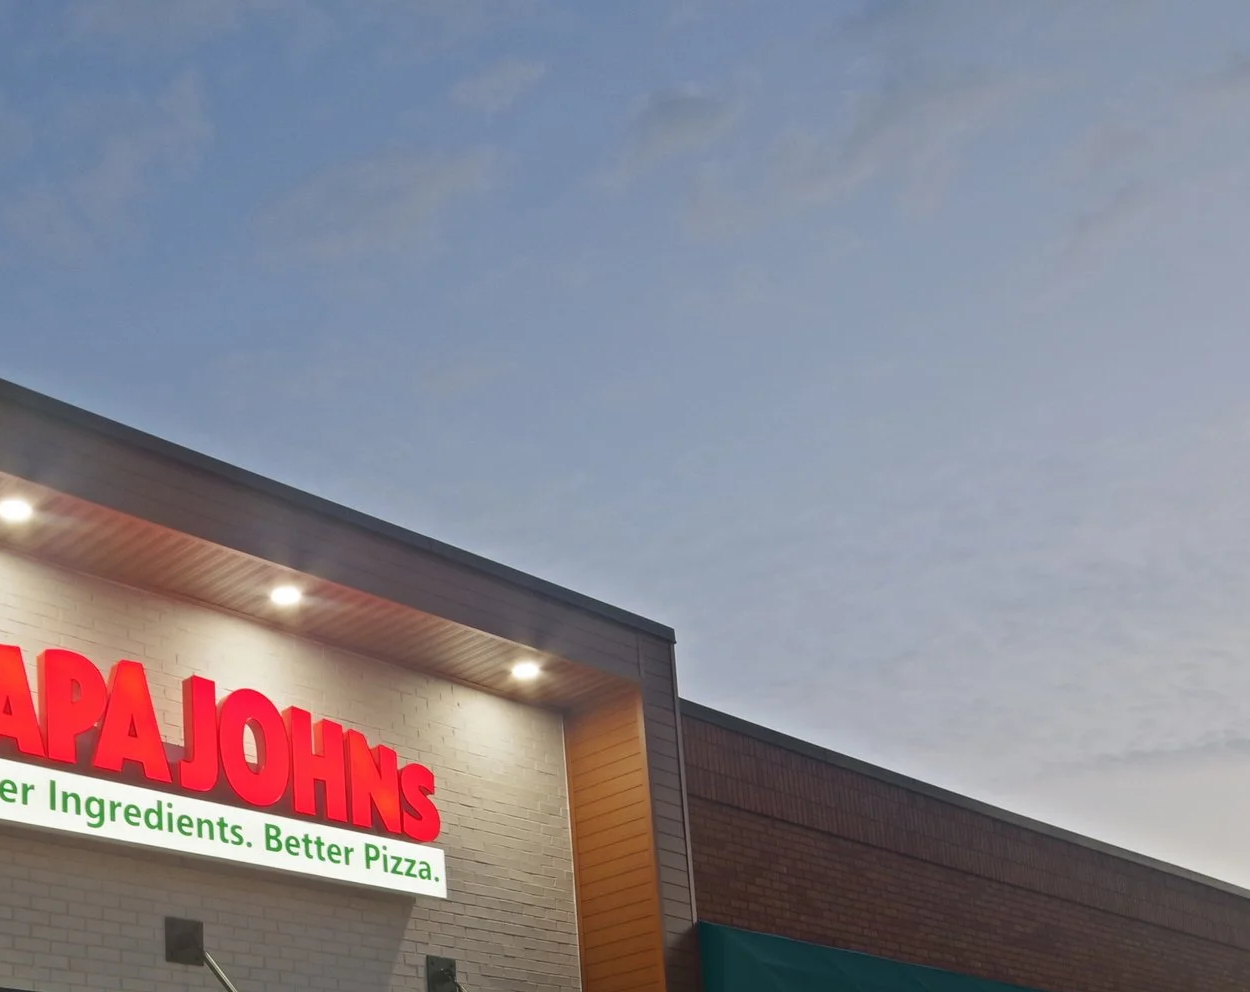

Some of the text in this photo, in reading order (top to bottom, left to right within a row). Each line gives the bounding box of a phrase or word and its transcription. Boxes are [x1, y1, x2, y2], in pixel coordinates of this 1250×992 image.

[180, 674, 441, 842] JOHNS
[49, 780, 253, 848] Ingredients.
[264, 824, 354, 867] Better
[364, 843, 440, 883] Pizza.
